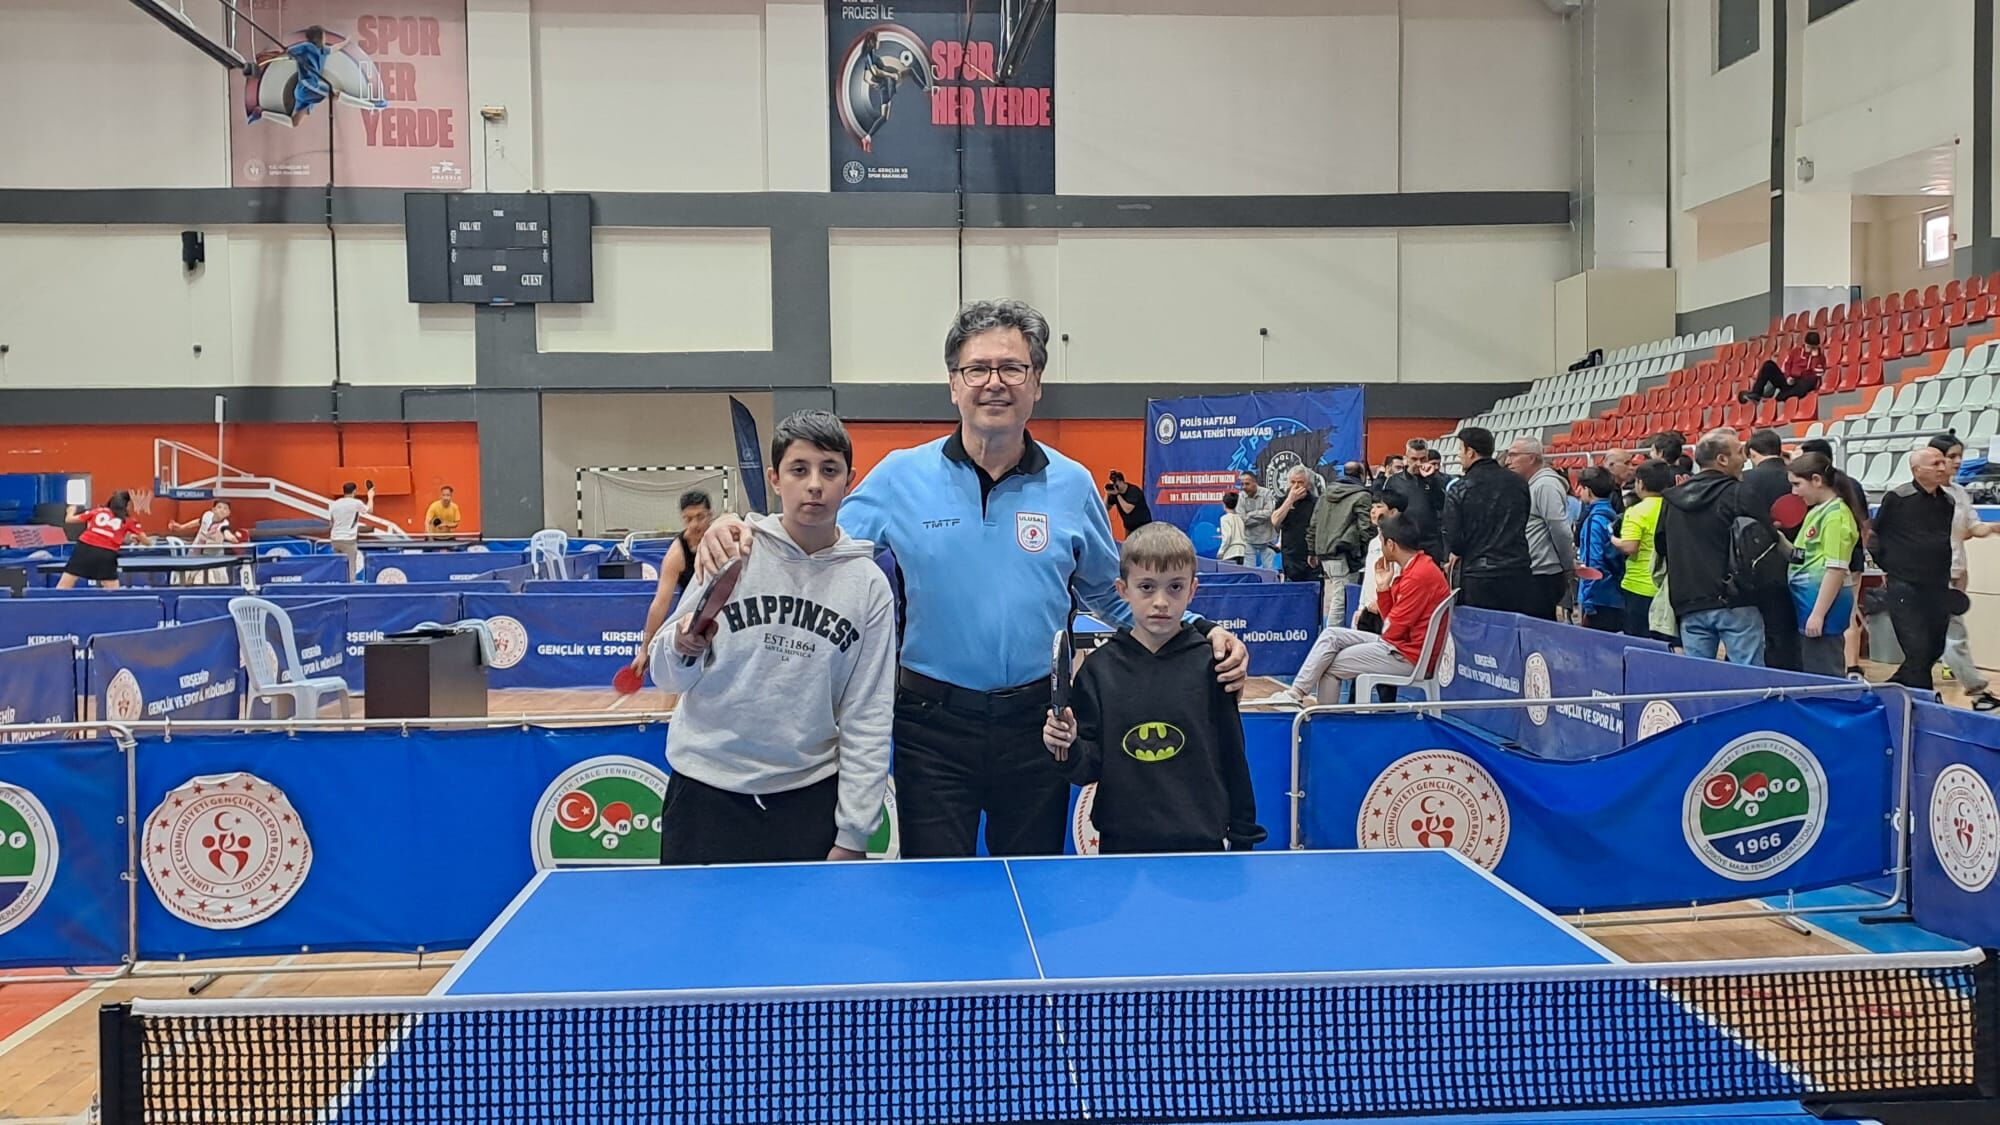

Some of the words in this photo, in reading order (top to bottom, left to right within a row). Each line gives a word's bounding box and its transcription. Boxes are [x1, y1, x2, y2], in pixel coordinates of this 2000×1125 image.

[842, 6, 879, 20] PROJESİ
[881, 6, 895, 20] İLE
[357, 15, 440, 56] SPOR
[931, 41, 994, 81] SPOR
[359, 60, 417, 101] HER
[931, 86, 975, 126] HER
[981, 87, 1050, 127] YERDE
[361, 108, 454, 148] YERDE
[522, 275, 543, 286] GUEST
[1180, 416, 1202, 427] POLİS
[1203, 416, 1237, 425] HAFTASI
[1180, 430, 1201, 439] MASA
[1203, 427, 1226, 438] TENİSİ
[1227, 427, 1272, 437] TURNUVASI
[1018, 515, 1045, 523] ULUSAL
[243, 571, 249, 584] 8
[722, 595, 860, 653] HAPPINESS
[602, 630, 645, 643] KIRŞEHİ
[764, 633, 816, 652] EST:1864
[1243, 629, 1308, 642] MÜDÜRLÜĞÜ
[537, 643, 584, 656] GENÇLİK
[587, 645, 602, 655] VE
[603, 645, 632, 655] SPOR
[174, 694, 184, 709] VE
[1555, 703, 1582, 721] GENÇLİK
[1582, 709, 1591, 723] VE
[1592, 711, 1609, 729] SPOR
[575, 770, 601, 784] TABLE
[605, 768, 637, 777] TENNIS
[639, 774, 665, 793] FEDER
[1416, 780, 1455, 791] GENÇLİK
[1456, 788, 1468, 799] VE
[210, 797, 254, 810] GENÇLİK
[255, 807, 267, 816] VE
[1465, 799, 1479, 821] SPOR
[264, 818, 279, 844] SPOR
[1463, 824, 1480, 856] BAKAN
[1735, 833, 1781, 855] 1966
[241, 846, 279, 892] BAKANLIĞI
[1729, 859, 1749, 871] MASA
[180, 864, 215, 894] TÜRKİYE
